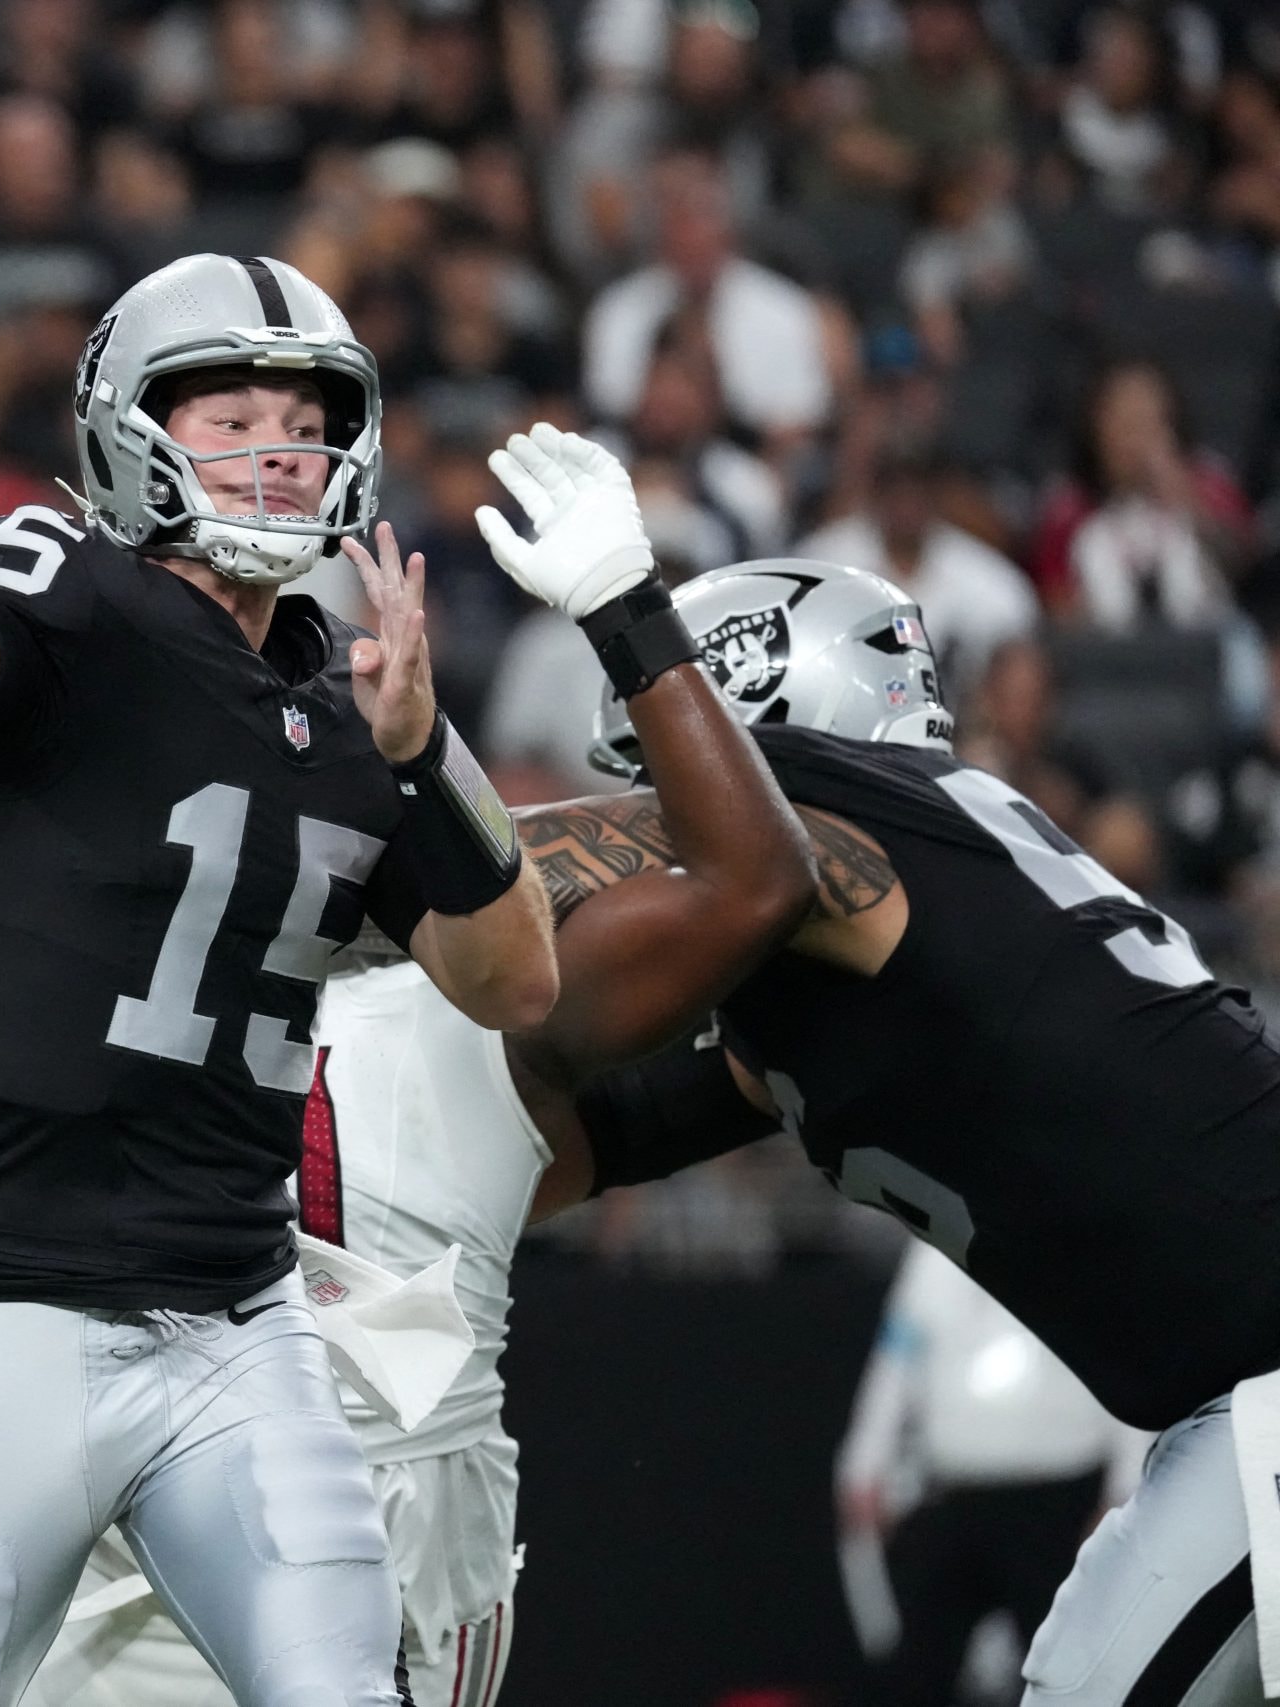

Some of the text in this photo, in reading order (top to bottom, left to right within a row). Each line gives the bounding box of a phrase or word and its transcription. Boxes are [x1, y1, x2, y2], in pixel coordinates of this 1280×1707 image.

[265, 330, 300, 339] AIDERS
[696, 609, 776, 650] RAIDERS
[105, 782, 388, 1095] 15
